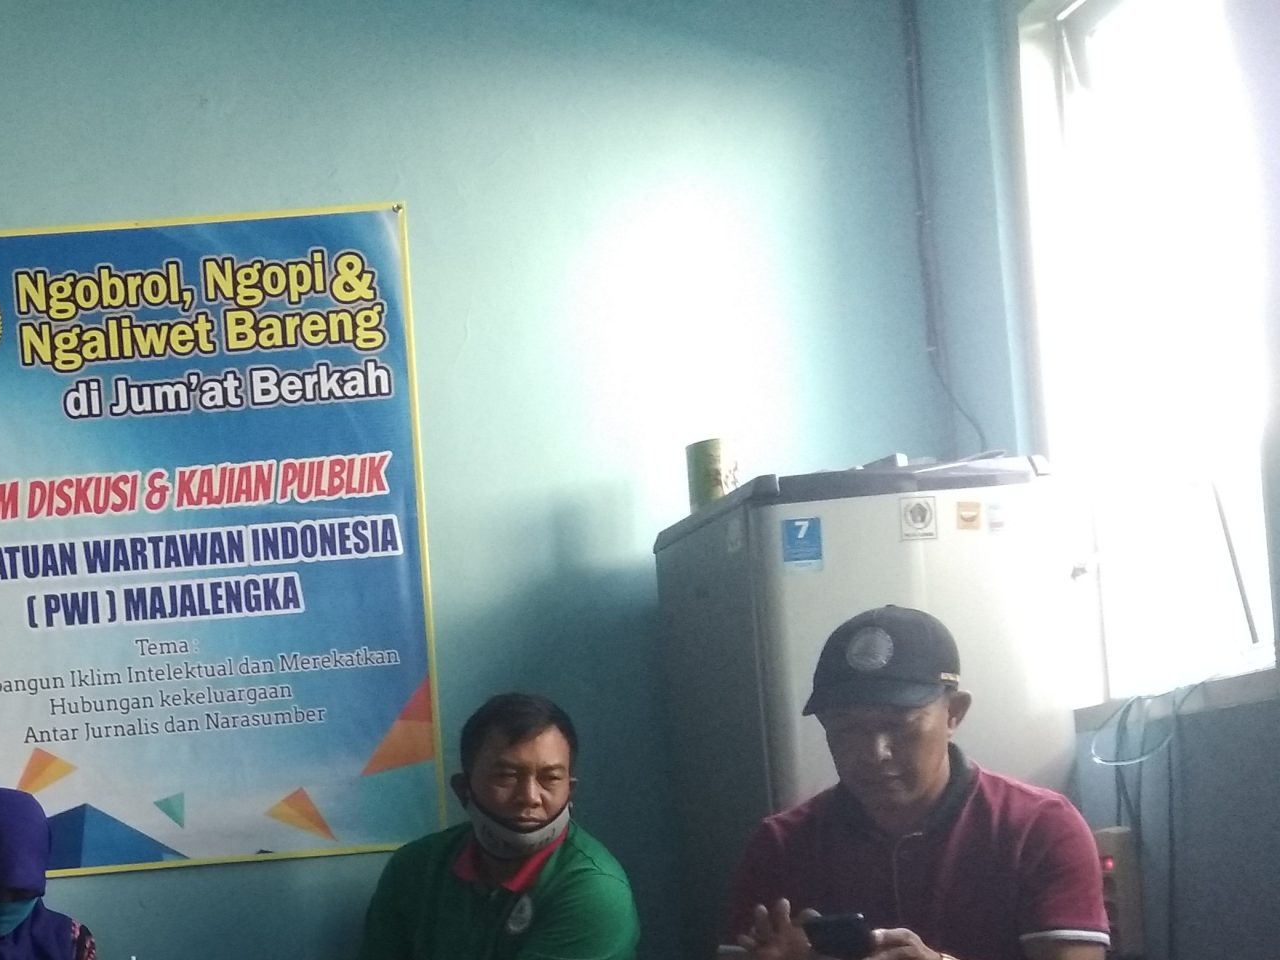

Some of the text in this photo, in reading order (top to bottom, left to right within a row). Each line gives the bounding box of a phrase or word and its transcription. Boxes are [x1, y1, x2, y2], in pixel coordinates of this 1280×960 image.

[16, 250, 375, 319] Ngobrol, Ngopi &
[20, 304, 385, 370] Ngaliwet Bareng
[65, 361, 391, 417] di Jum'at Berkah
[27, 474, 138, 519] DISKUSI
[144, 471, 170, 511] &
[176, 463, 274, 508] KAJIAN
[279, 454, 389, 501] PULBLIK
[82, 530, 245, 574] WARTAWAN
[251, 518, 399, 562] INDONESIA
[793, 520, 810, 539] 7
[44, 591, 101, 628] PWI
[123, 576, 301, 622] MAJALENGKA
[70, 668, 121, 688] Iklim
[127, 658, 234, 684] Intelektual
[238, 656, 274, 675] dan
[279, 647, 400, 672] Merekatkan
[135, 638, 188, 657] Tema
[24, 706, 327, 744] Antar Jurnalis dan Narasumber
[49, 684, 293, 716] Hubungan kekeluargaan
